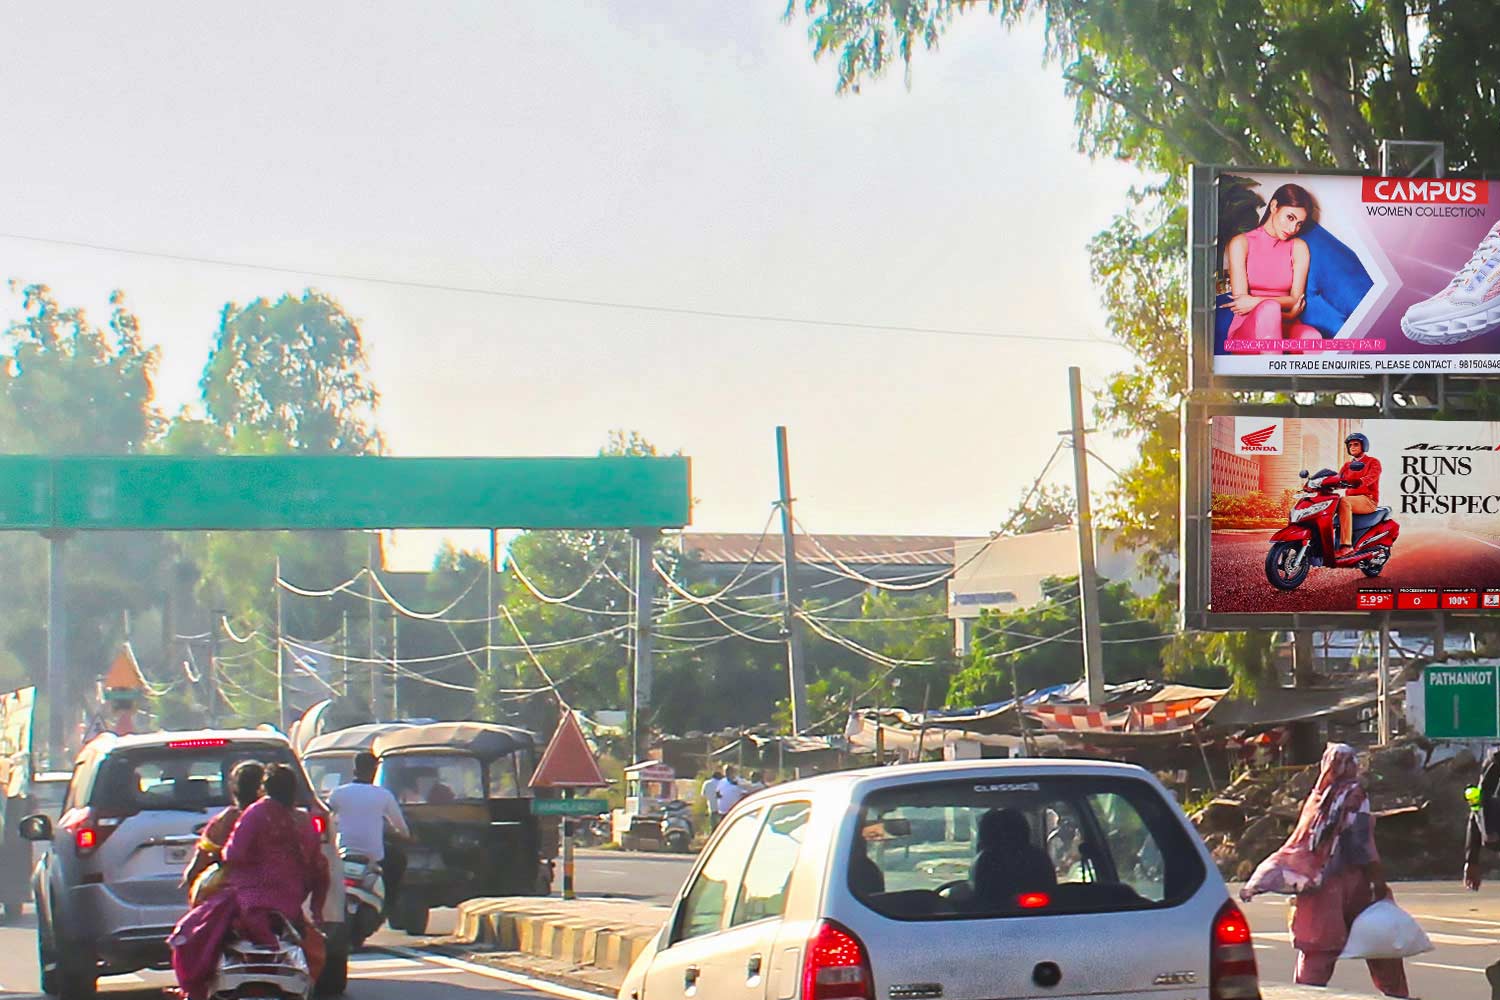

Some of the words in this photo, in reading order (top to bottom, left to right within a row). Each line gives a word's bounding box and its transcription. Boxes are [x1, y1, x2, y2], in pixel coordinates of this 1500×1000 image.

[1374, 181, 1477, 202] CAMPUS
[1366, 206, 1412, 217] WOMEN
[1415, 206, 1486, 217] COLLECTION
[1312, 340, 1323, 349] IN
[1360, 340, 1381, 349] PAIR
[1268, 361, 1287, 370] FOR
[1290, 361, 1319, 370] TRADE
[1322, 361, 1373, 371] ENQUIRIES,
[1375, 361, 1411, 370] PLEASE
[1413, 361, 1451, 369] CONTACT
[1404, 443, 1493, 451] ACTIVA
[1401, 456, 1472, 475] RUNS
[1400, 475, 1439, 494] ON
[1430, 672, 1492, 685] PATHANKOT
